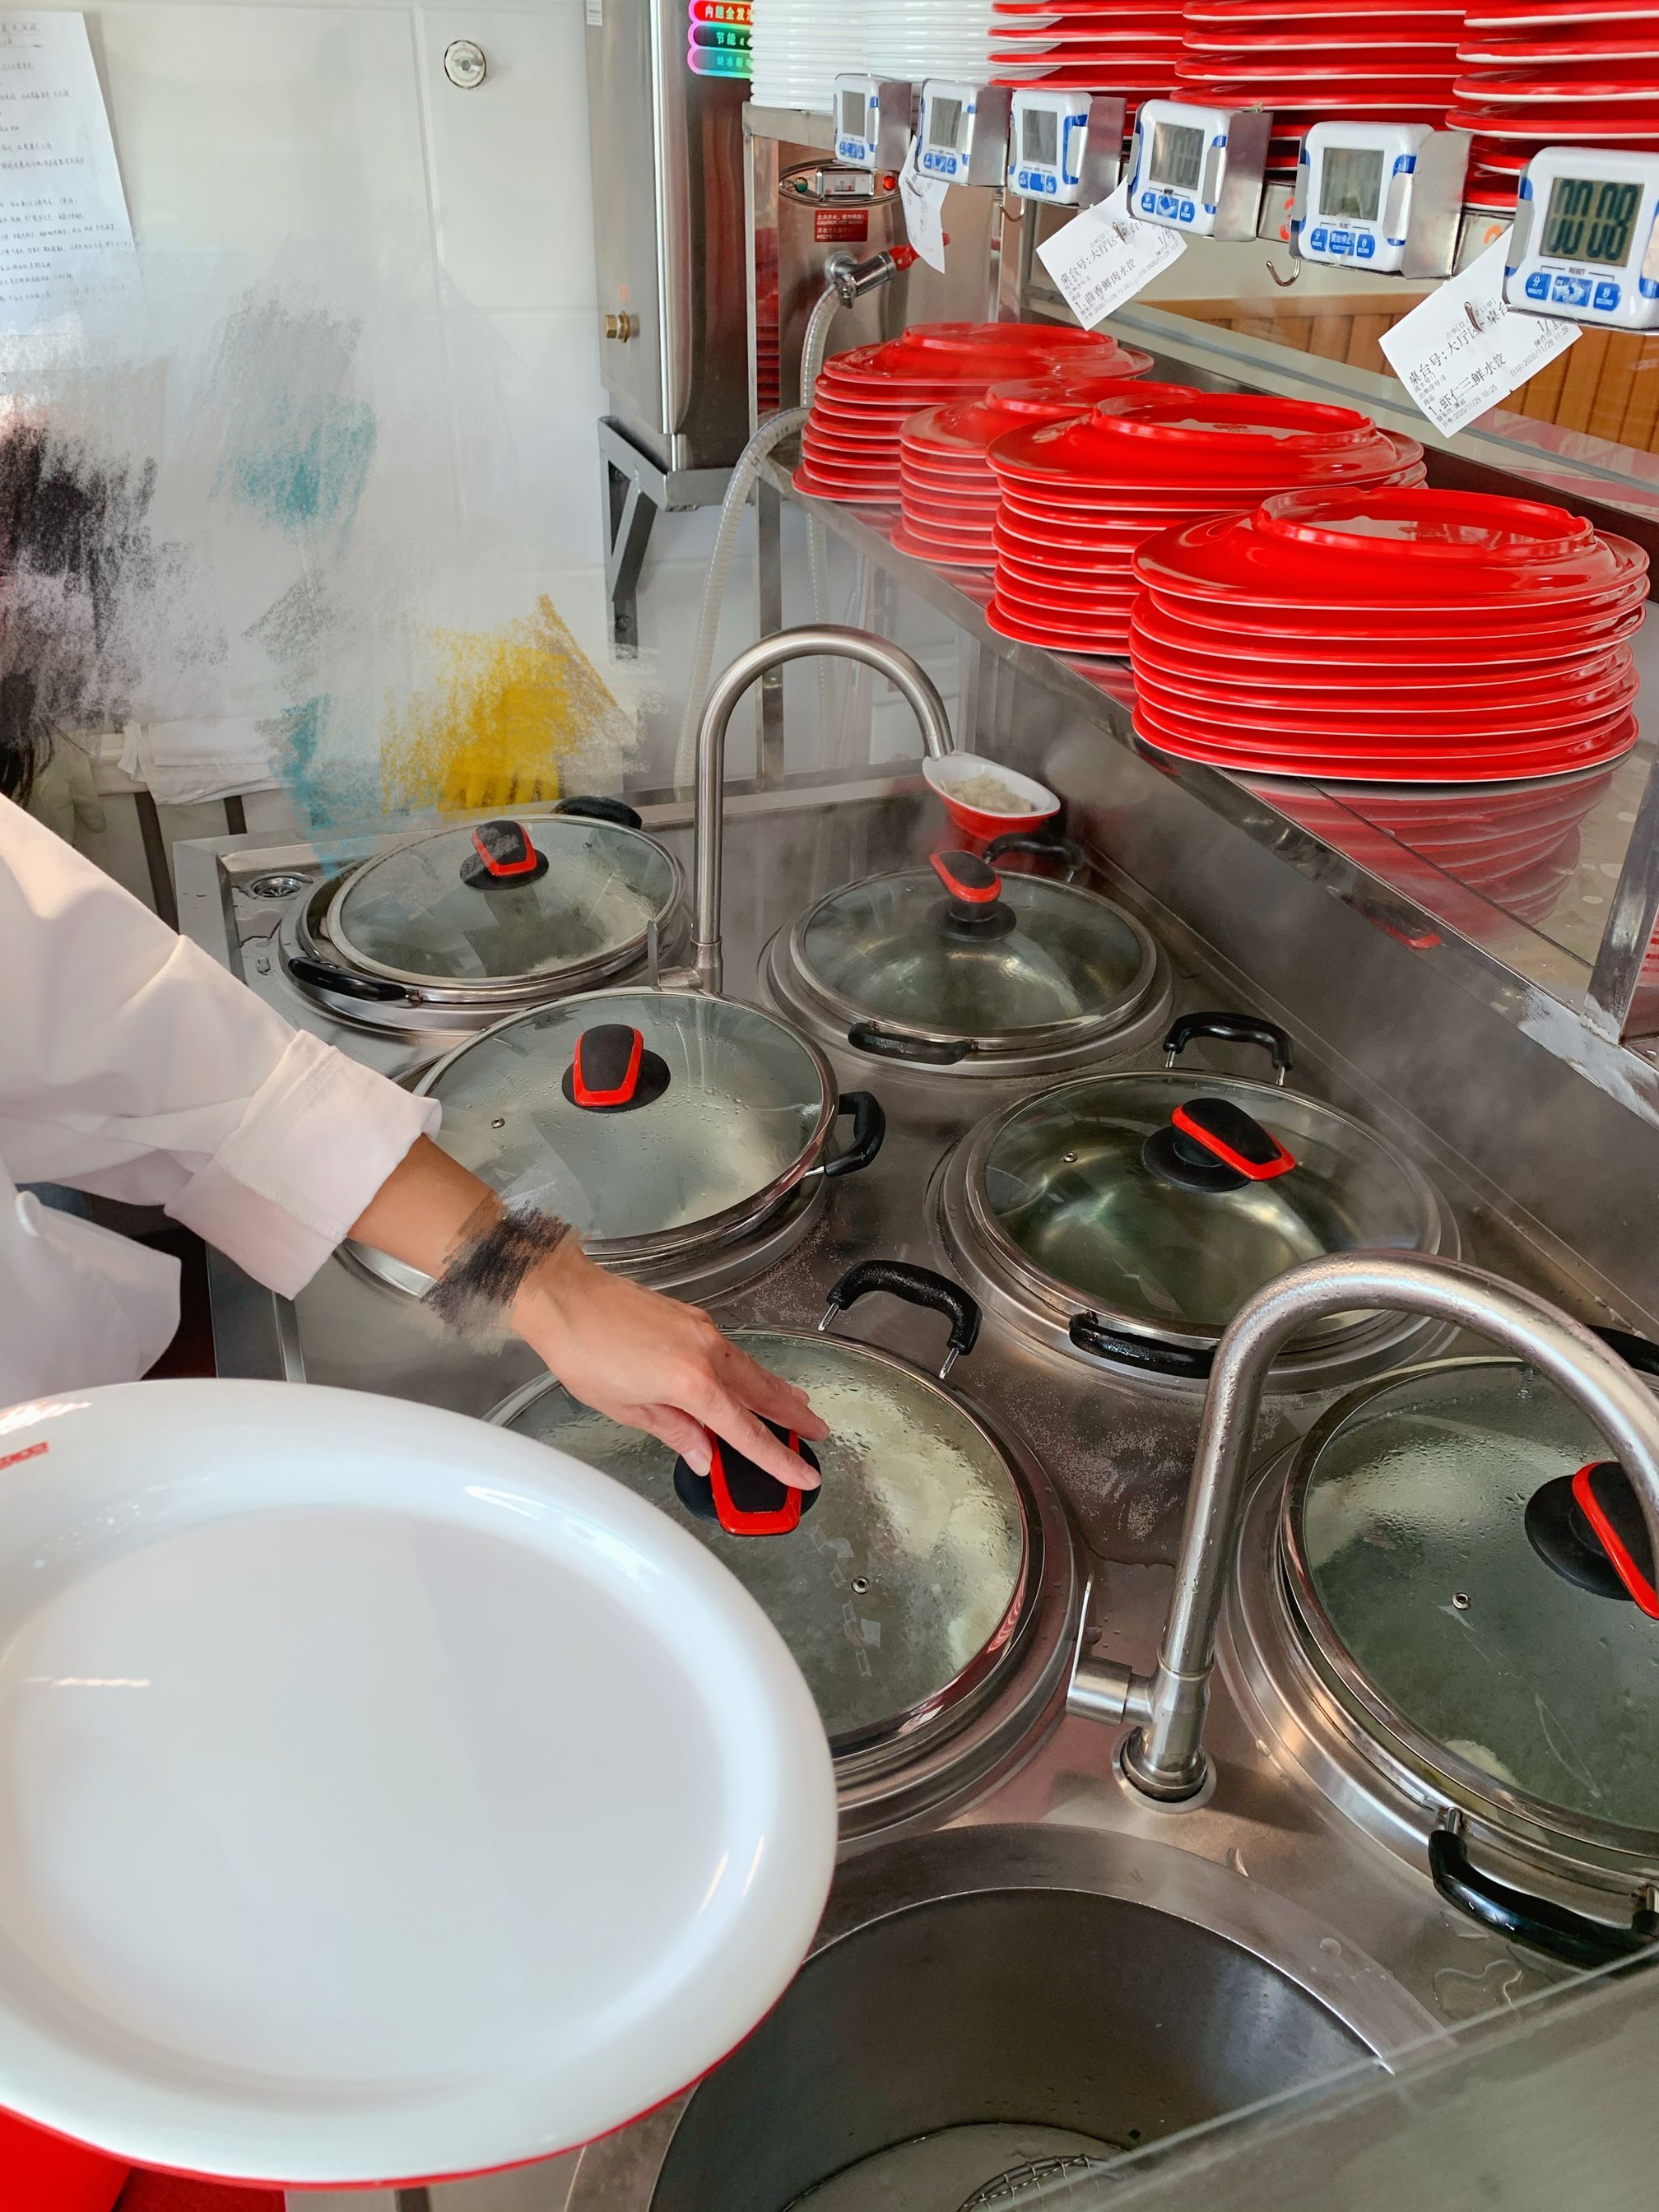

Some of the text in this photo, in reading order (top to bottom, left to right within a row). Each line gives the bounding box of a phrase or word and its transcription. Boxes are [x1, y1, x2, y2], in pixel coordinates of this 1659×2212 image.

[1596, 297, 1614, 306] SECOND
[1428, 352, 1507, 416] 1.虾仁三鲜水饺
